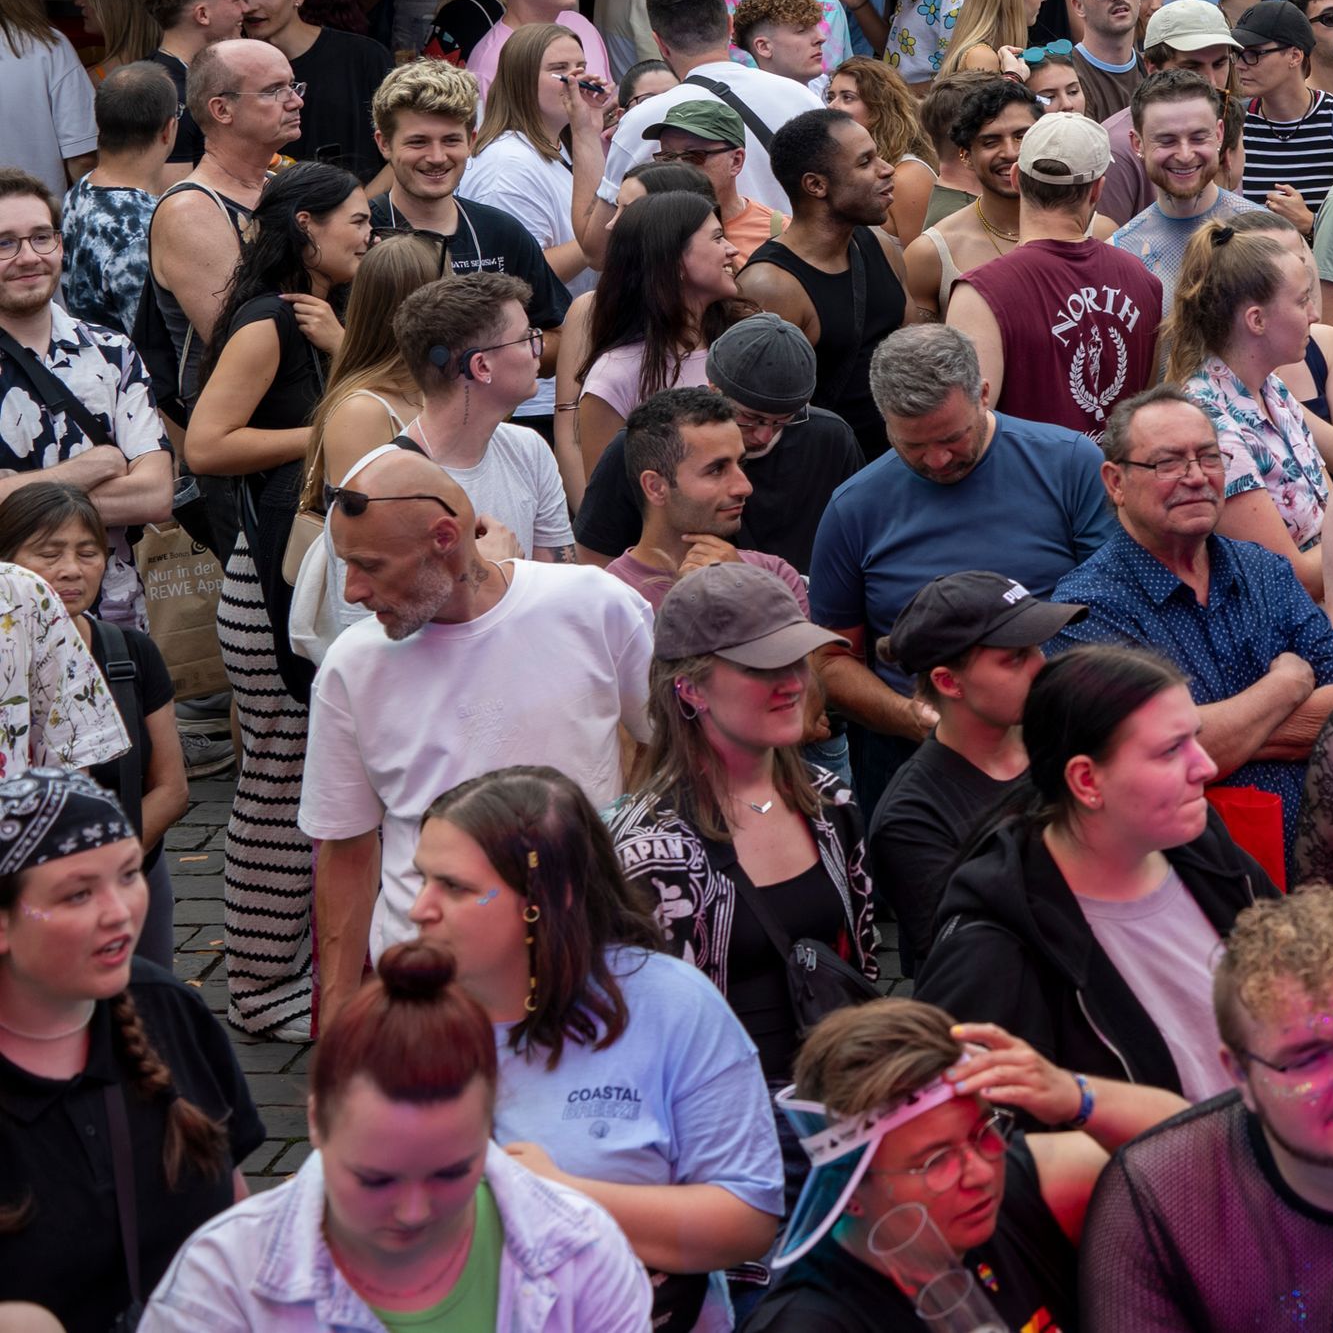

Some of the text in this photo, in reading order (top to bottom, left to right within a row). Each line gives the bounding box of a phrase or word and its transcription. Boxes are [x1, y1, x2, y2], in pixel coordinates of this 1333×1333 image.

[1051, 285, 1141, 347] NORTH
[147, 562, 216, 583] Nur in der
[150, 582, 193, 601] REWE
[623, 838, 685, 867] APAN
[567, 1085, 643, 1104] COASTAL
